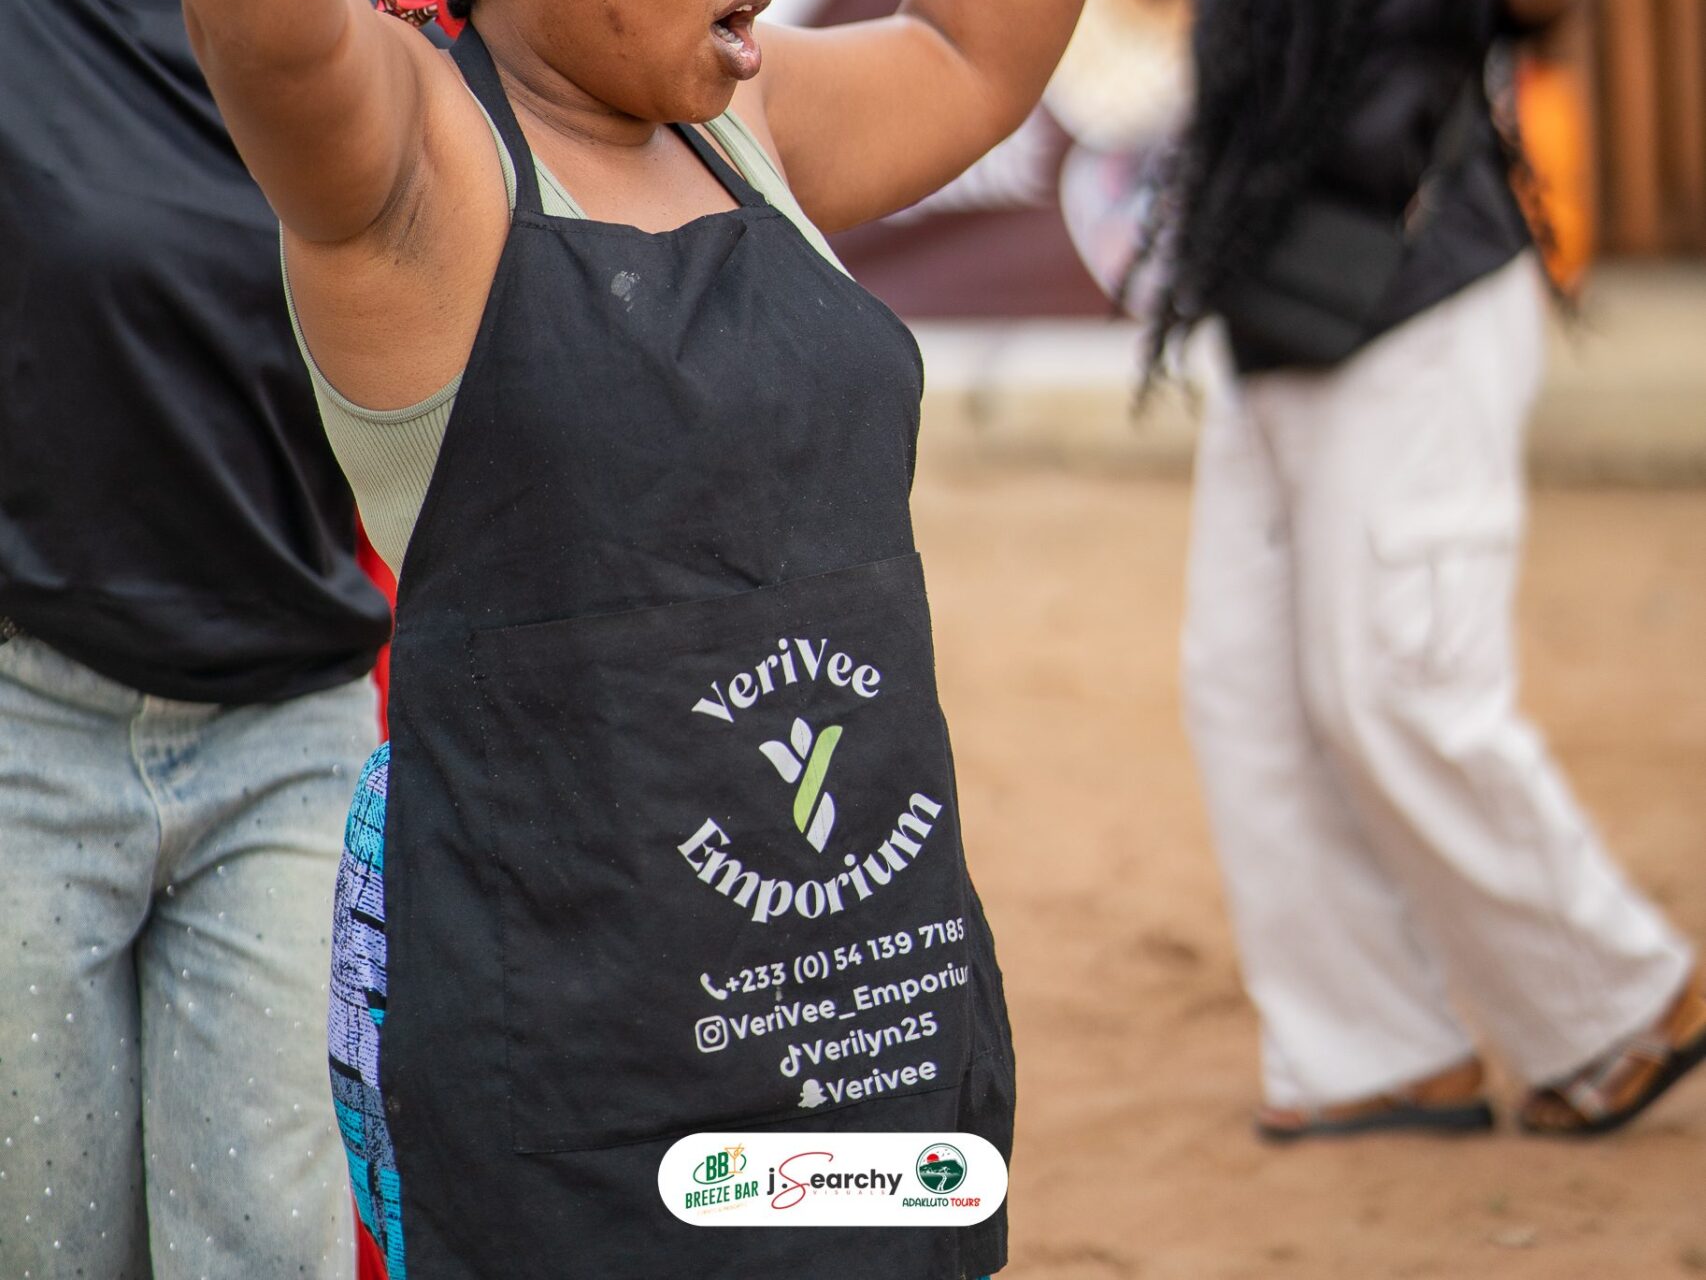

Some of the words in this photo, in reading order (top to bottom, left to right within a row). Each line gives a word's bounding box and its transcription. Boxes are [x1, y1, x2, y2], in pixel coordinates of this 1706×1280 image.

[691, 638, 881, 723] VeriVee
[677, 792, 943, 923] Emporium
[725, 962, 786, 993] +233
[793, 951, 829, 984] (0)
[834, 943, 863, 971] 54
[867, 931, 913, 961] 139
[918, 917, 965, 949] 7185
[728, 962, 969, 1040] VeriVee_Emporiu
[801, 1011, 938, 1065] Verilyn25
[825, 1061, 937, 1105] Verivee
